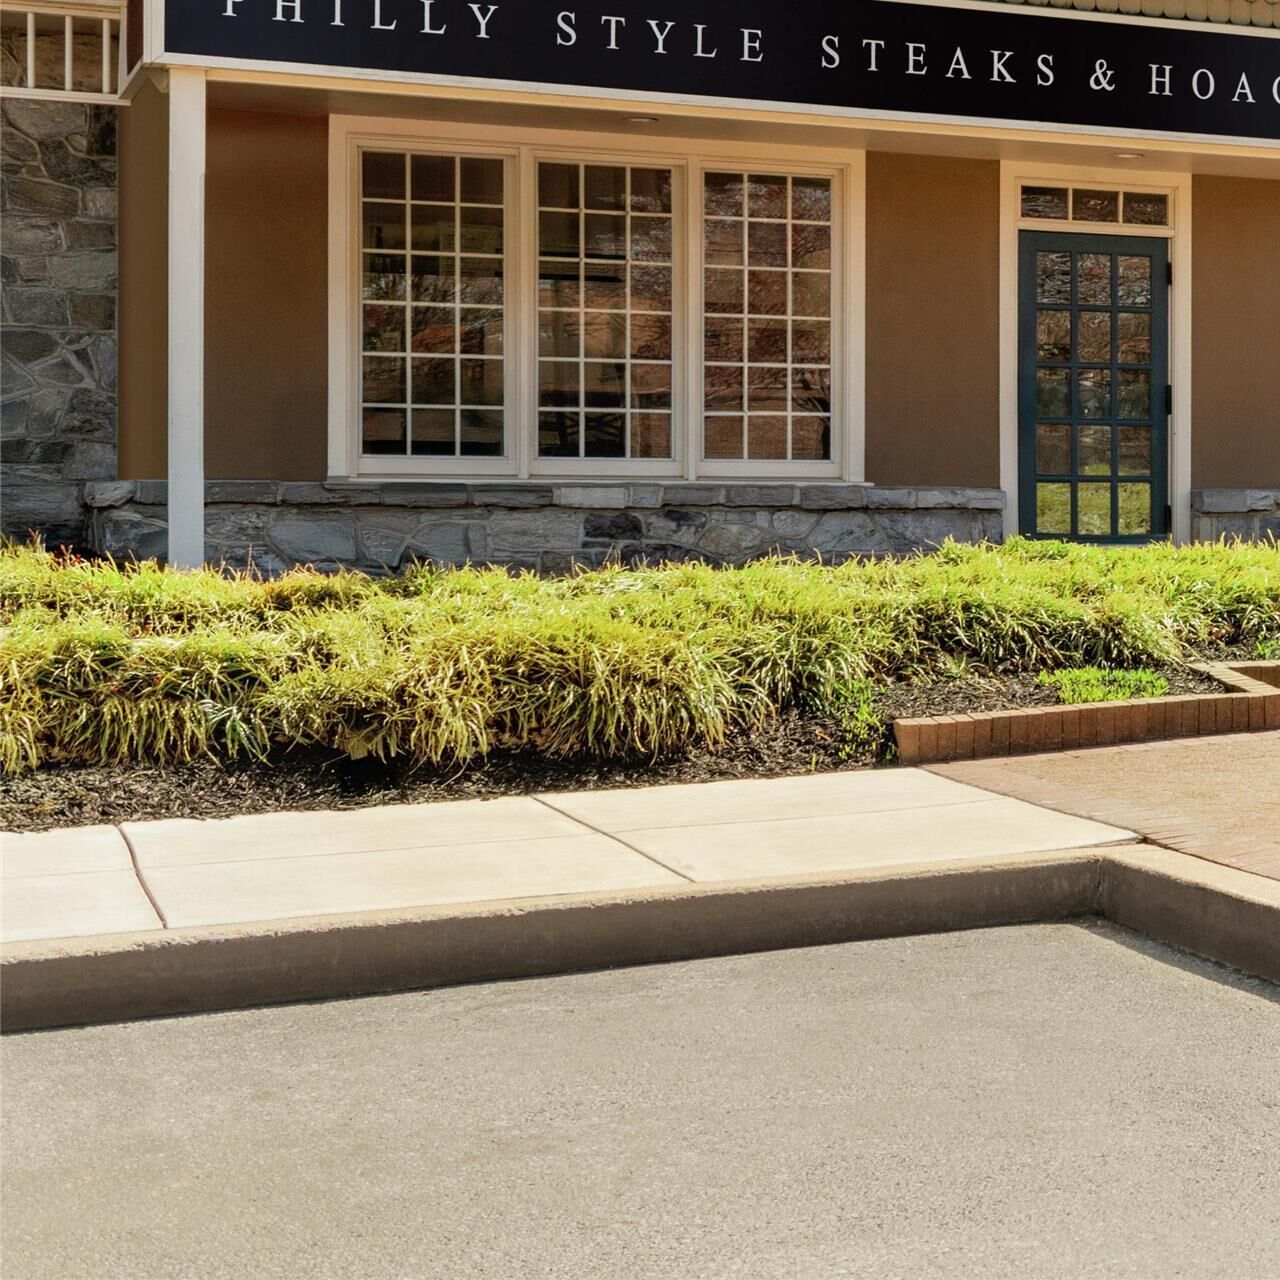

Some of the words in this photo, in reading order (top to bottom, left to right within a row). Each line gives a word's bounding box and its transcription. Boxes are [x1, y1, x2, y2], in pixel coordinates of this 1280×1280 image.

[556, 11, 764, 62] STYLE
[821, 35, 1055, 87] STEAKS
[1089, 59, 1116, 91] &
